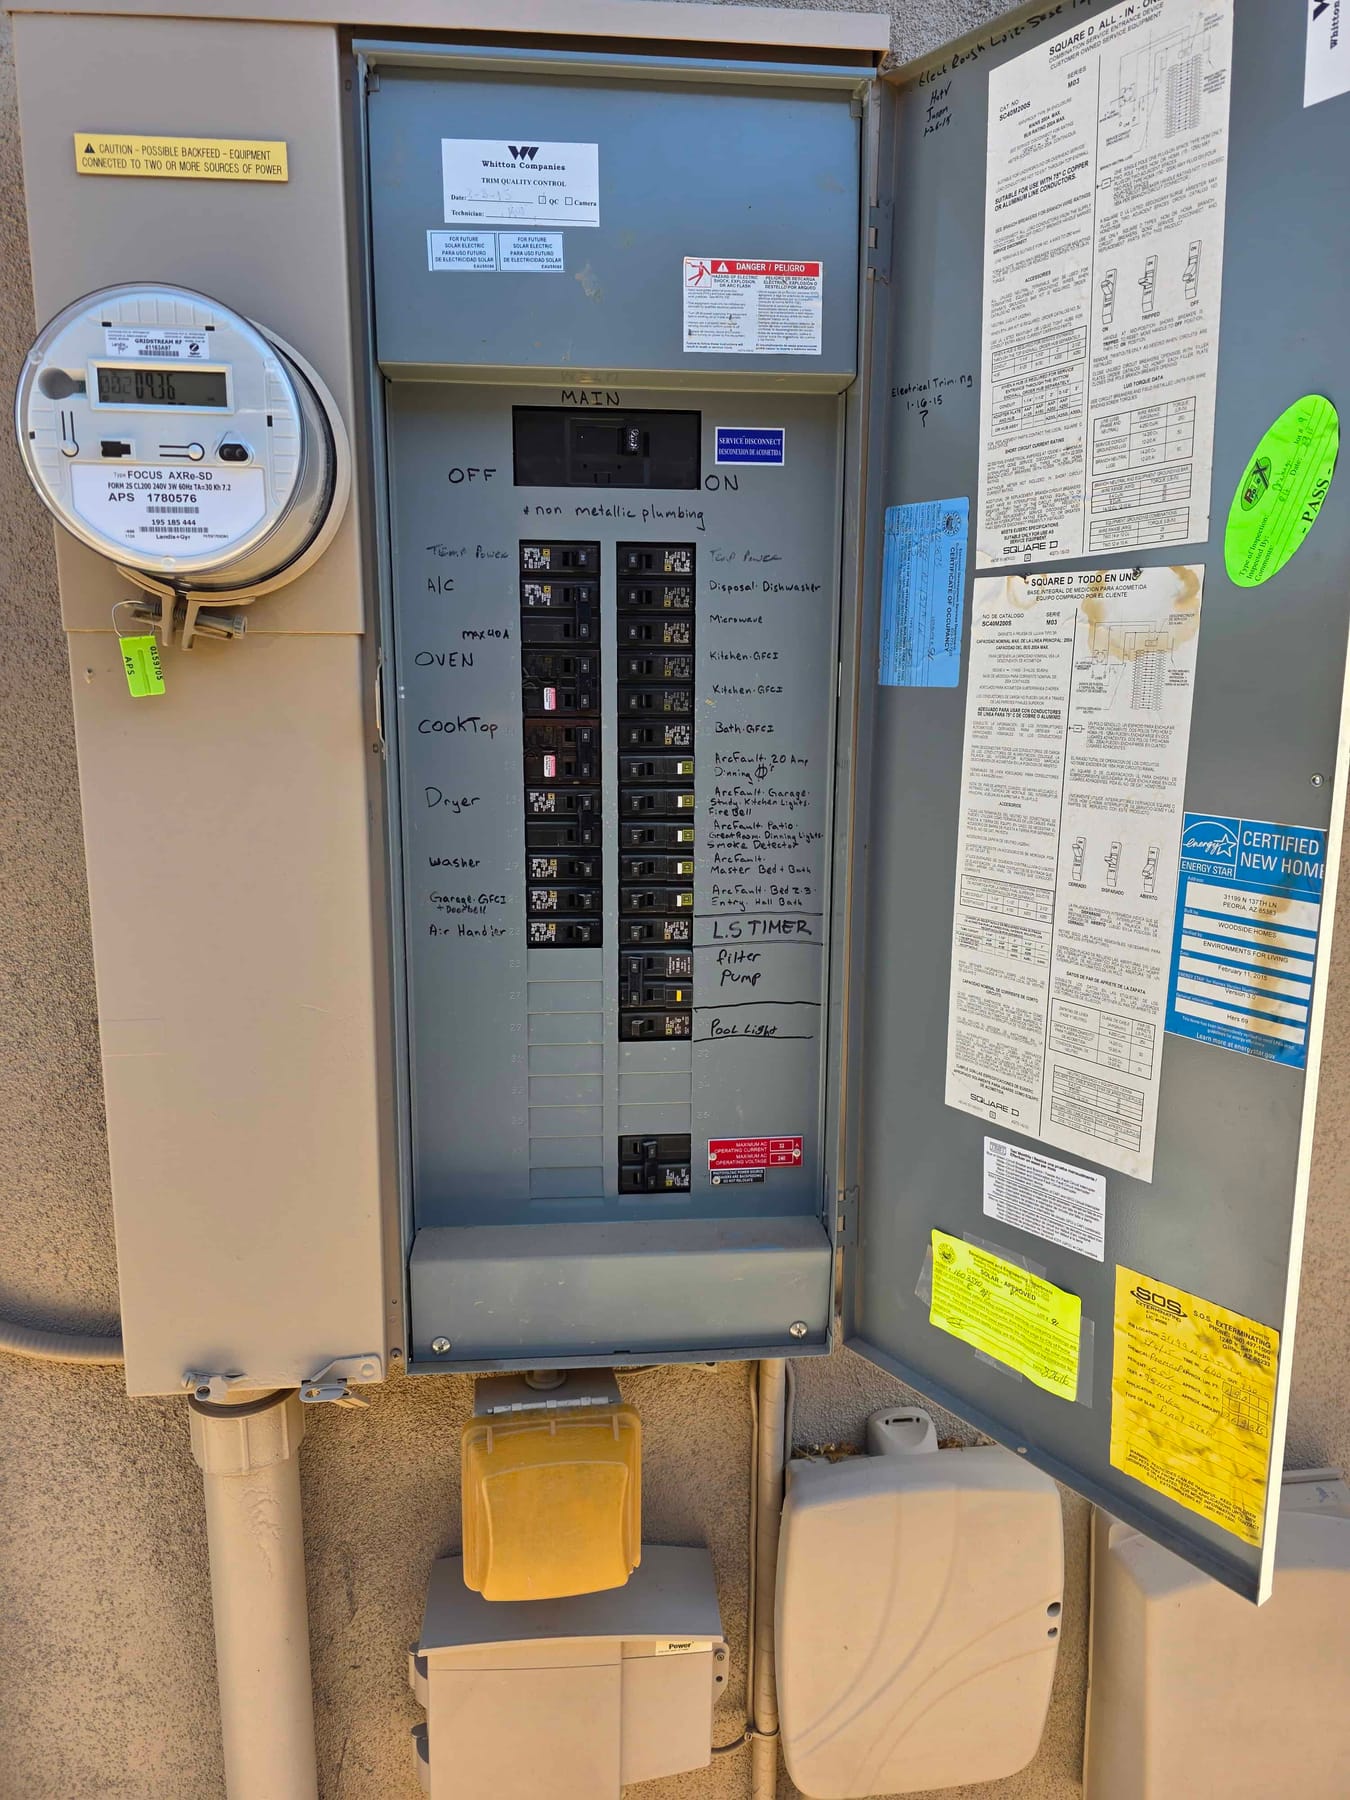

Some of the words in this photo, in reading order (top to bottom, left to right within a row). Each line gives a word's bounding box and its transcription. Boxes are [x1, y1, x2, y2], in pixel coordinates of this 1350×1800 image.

[1049, 30, 1085, 56] SQUARE
[1087, 26, 1094, 36] D
[1099, 16, 1116, 30] ALL
[1124, 5, 1134, 18] IN
[99, 143, 133, 155] CAUTION
[141, 144, 179, 157] POSSIBLE
[182, 146, 220, 158] BACKFEED
[229, 148, 271, 160] EQUIPMENT
[82, 157, 128, 168] CONNECTED
[130, 158, 141, 169] TO
[144, 159, 162, 170] TWO
[166, 160, 177, 170] OR
[179, 160, 200, 172] MORE
[204, 162, 240, 174] SOURCES
[242, 163, 252, 174] OF
[254, 164, 282, 176] POWER
[482, 160, 516, 168] Whitton
[520, 162, 566, 171] Companies
[500, 178, 532, 186] QUALITY
[736, 262, 766, 271] DANGER
[774, 263, 806, 272] PELIGRO
[890, 380, 931, 398] Electrical
[560, 390, 620, 406] MAIN
[128, 470, 163, 480] FOCUS
[168, 471, 212, 480] AXRe-SD
[448, 468, 497, 484] OFF
[704, 474, 740, 492] ON
[108, 482, 124, 490] FORM
[134, 482, 152, 490] CL200
[152, 482, 166, 490] 240V
[108, 492, 135, 502] APS
[147, 493, 197, 502] 1780576
[1302, 478, 1330, 523] PASS
[535, 506, 562, 516] non
[576, 504, 636, 519] metallic
[642, 503, 706, 531] plumbing
[1002, 542, 1046, 555] SQUARE
[1050, 540, 1058, 549] D
[1239, 560, 1250, 576] Type
[1250, 512, 1270, 550] Inspection:
[948, 546, 956, 594] CERTIFICATE
[1246, 548, 1264, 580] Inspected
[427, 576, 456, 594] A/C
[762, 580, 821, 593] Dishwasher
[1032, 577, 1065, 587] SQUARE
[1067, 576, 1074, 585] D
[1078, 574, 1102, 584] TODO
[1104, 574, 1116, 584] EN
[947, 595, 952, 604] OF
[710, 614, 764, 625] Microwave
[125, 656, 135, 676] APS
[414, 651, 474, 668] OVEN
[770, 754, 786, 764] 20
[790, 755, 809, 766] Amp
[425, 786, 480, 814] Dryer
[708, 807, 728, 816] Fire
[732, 808, 752, 816] Bell
[1242, 830, 1320, 856] CERTIFIED
[710, 864, 750, 874] Master
[758, 864, 778, 874] Bed
[1182, 860, 1212, 874] ENERGY
[1213, 864, 1233, 878] STAR
[1240, 852, 1278, 872] NEW
[770, 884, 789, 895] Bed
[748, 919, 812, 936] TIMER
[1218, 922, 1252, 934] WOODSIDE
[1253, 928, 1277, 938] HOMES
[1203, 940, 1252, 956] ENVIRONMENTS
[1252, 950, 1266, 958] FOR
[1267, 954, 1288, 963] LIVING
[1218, 965, 1242, 976] February
[1253, 972, 1268, 980] 2015
[970, 1092, 1009, 1114] SQUARE
[1010, 1108, 1020, 1117] D
[980, 1269, 1000, 1282] SOLAR
[1004, 1282, 1036, 1302] APPROVED
[1136, 1286, 1183, 1315] SOS
[1136, 1300, 1182, 1324] EXTERMINATING
[1193, 1310, 1212, 1322] S.O.S.
[1216, 1320, 1272, 1349] EXTERMINATING
[1208, 1324, 1230, 1338] PHONE:
